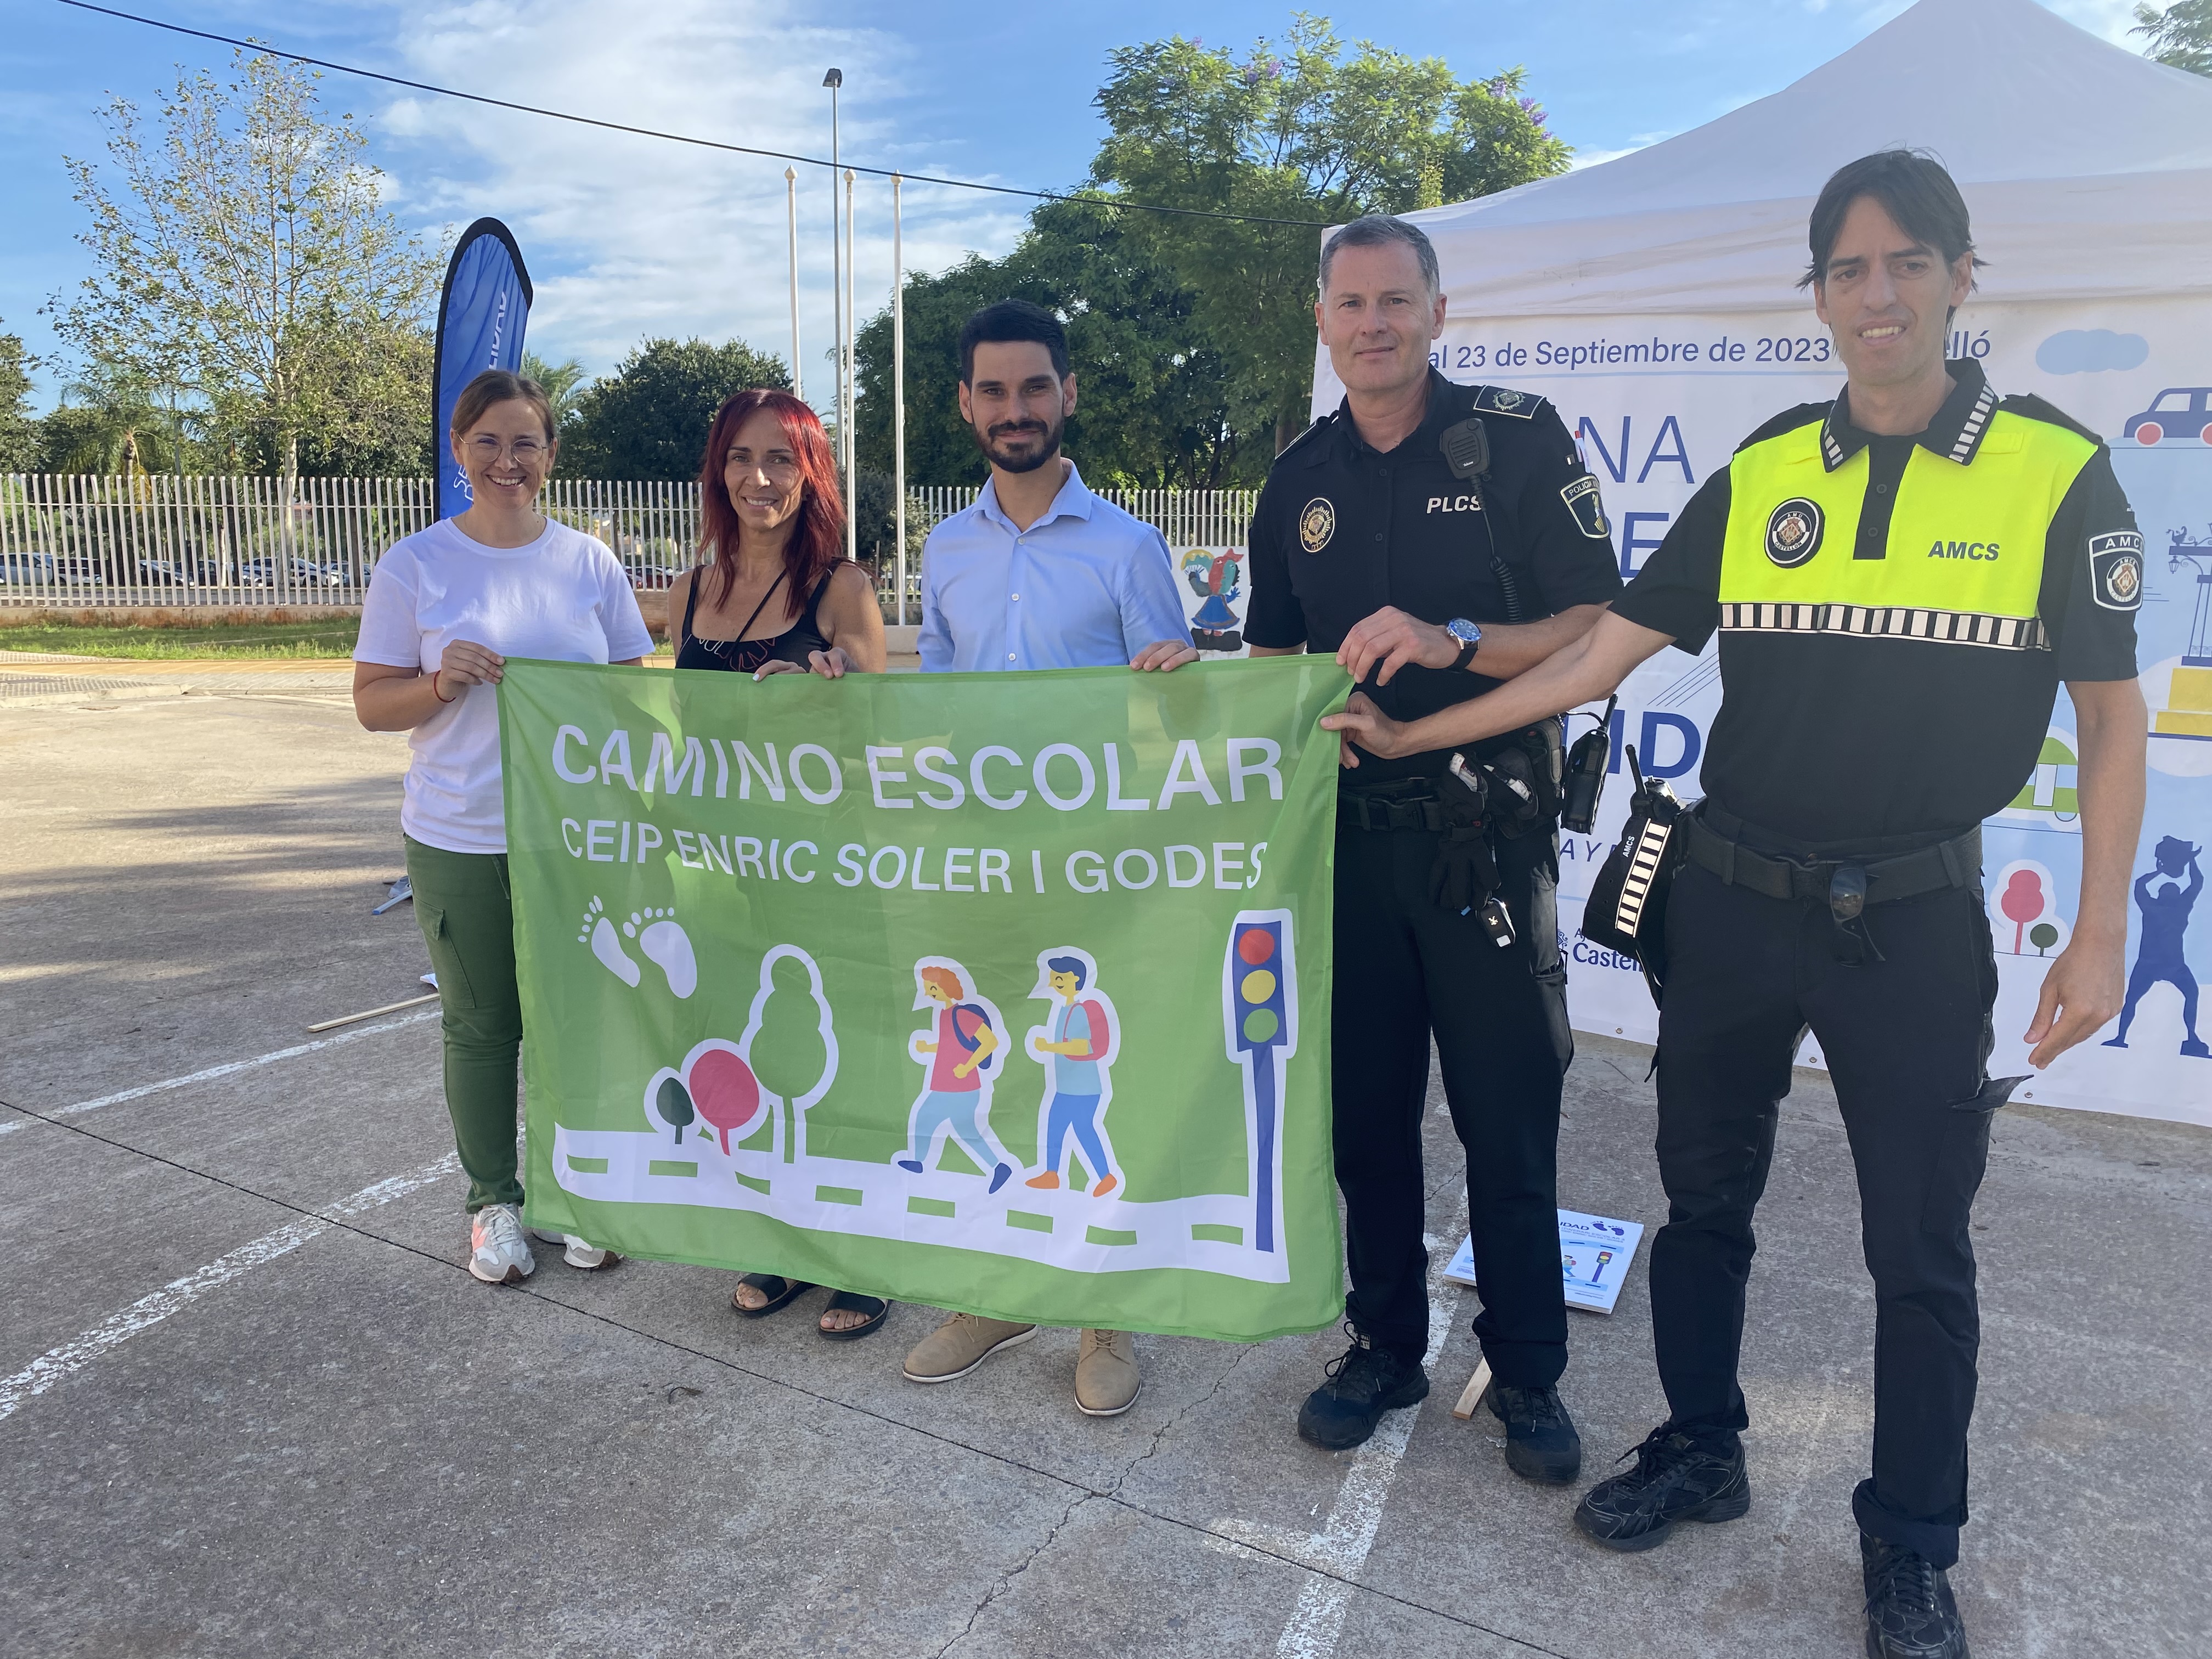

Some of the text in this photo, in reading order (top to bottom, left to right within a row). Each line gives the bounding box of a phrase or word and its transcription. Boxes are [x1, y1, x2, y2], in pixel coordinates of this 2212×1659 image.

[1429, 330, 1990, 370] al 23 de Septiembre de 2023 lló
[1578, 416, 1695, 483] NA
[1426, 495, 1481, 514] PLCS
[1928, 540, 2000, 561] AMCS
[551, 724, 1283, 811] CAMINO ESCOLAR
[561, 817, 1268, 894] CEIP ENRIC SOLER I GODES
[1622, 836, 1635, 857] AMCS
[1560, 1222, 1589, 1231] IDAD
